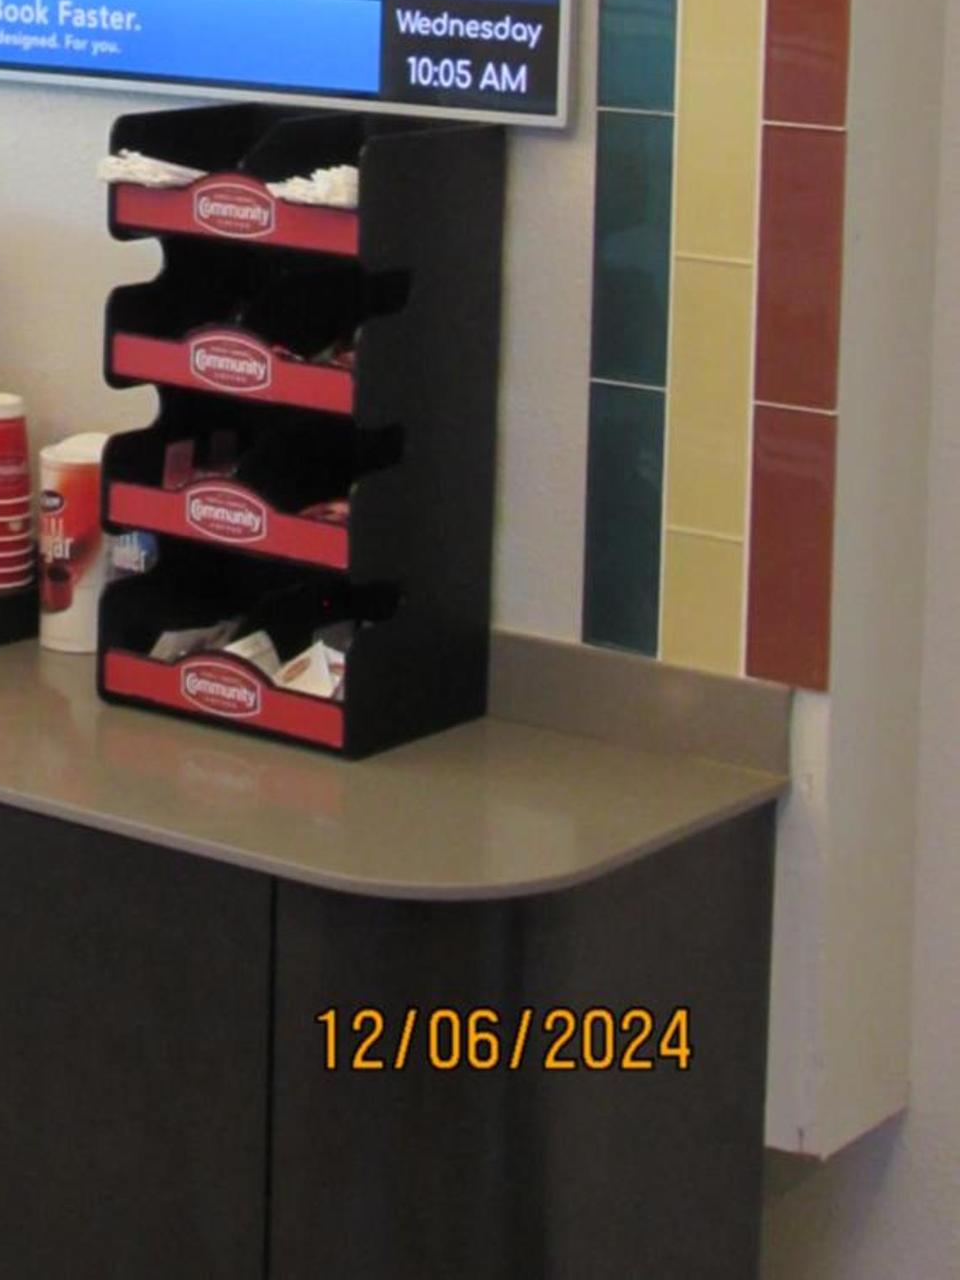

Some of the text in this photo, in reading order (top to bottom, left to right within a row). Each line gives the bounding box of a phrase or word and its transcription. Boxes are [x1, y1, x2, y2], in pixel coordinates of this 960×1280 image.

[58, 0, 142, 31] Faster.
[396, 8, 542, 48] Wednesday
[64, 33, 89, 51] For
[91, 37, 123, 55] you.
[407, 56, 528, 94] 10:05 AM
